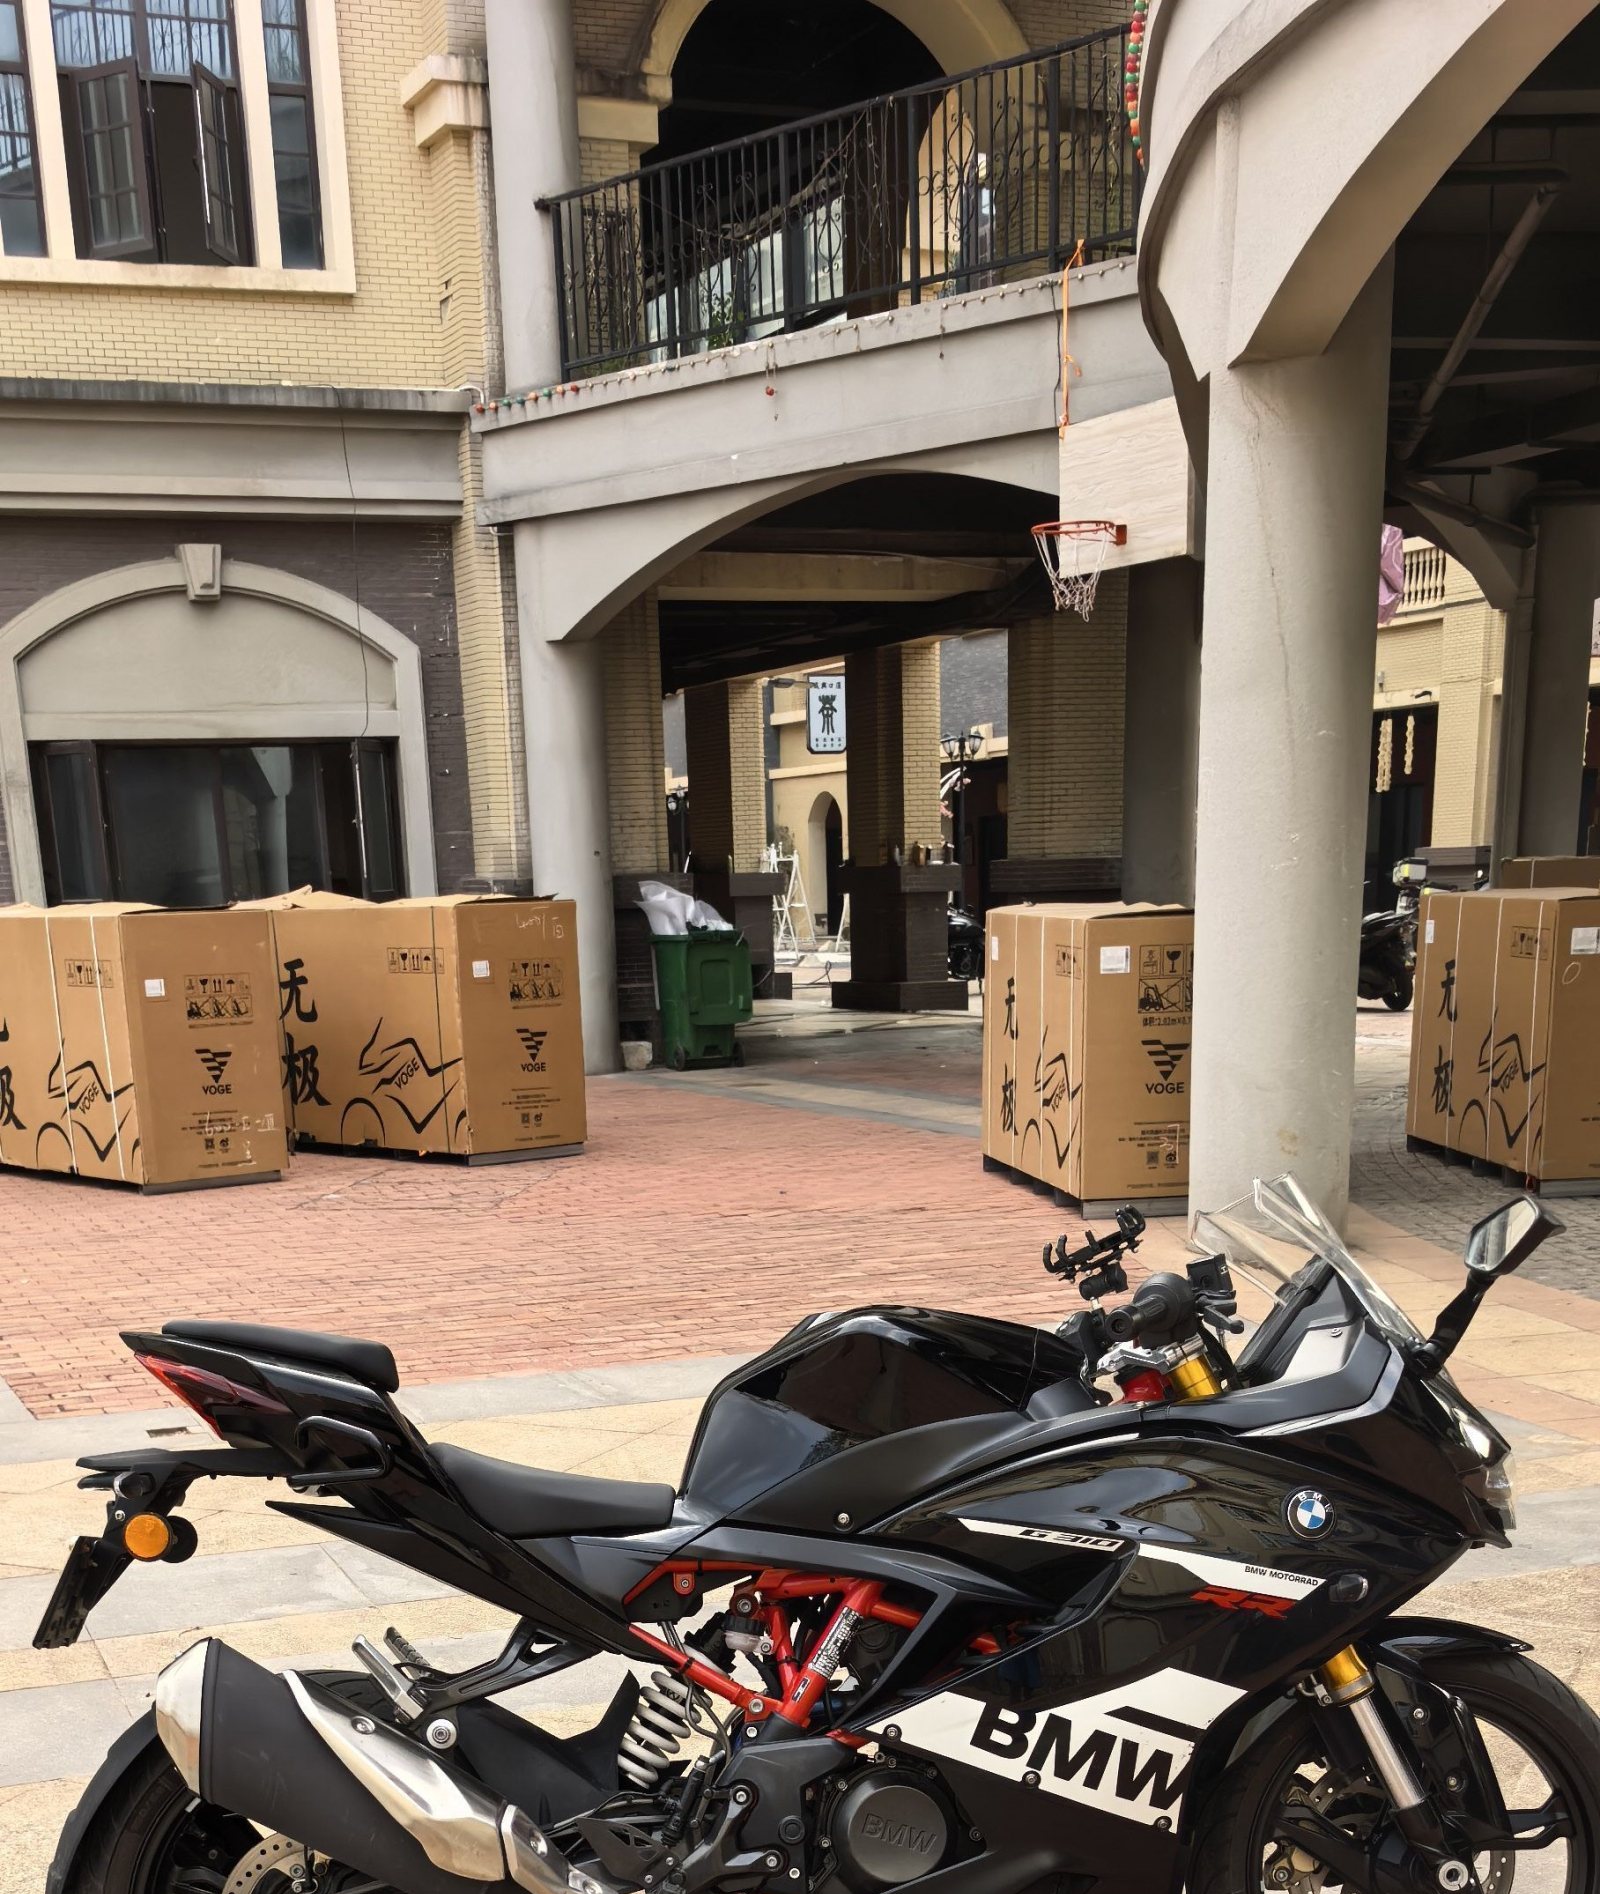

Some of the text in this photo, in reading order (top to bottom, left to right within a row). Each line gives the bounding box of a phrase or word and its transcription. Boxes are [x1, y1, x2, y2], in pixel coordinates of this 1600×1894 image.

[279, 958, 332, 1106] 无极
[395, 1057, 420, 1089] VOGE
[518, 1062, 546, 1072] VOGE
[79, 1081, 100, 1114] VOGE
[202, 1084, 232, 1095] VOGE
[1145, 1082, 1185, 1094] VOGE
[1298, 1492, 1333, 1513] BMW
[1019, 1529, 1119, 1547] G 310
[1244, 1565, 1319, 1586] BMW MOTORRAD
[1190, 1585, 1297, 1620] RR
[969, 1700, 1190, 1811] BMW
[861, 1813, 937, 1854] BMW
